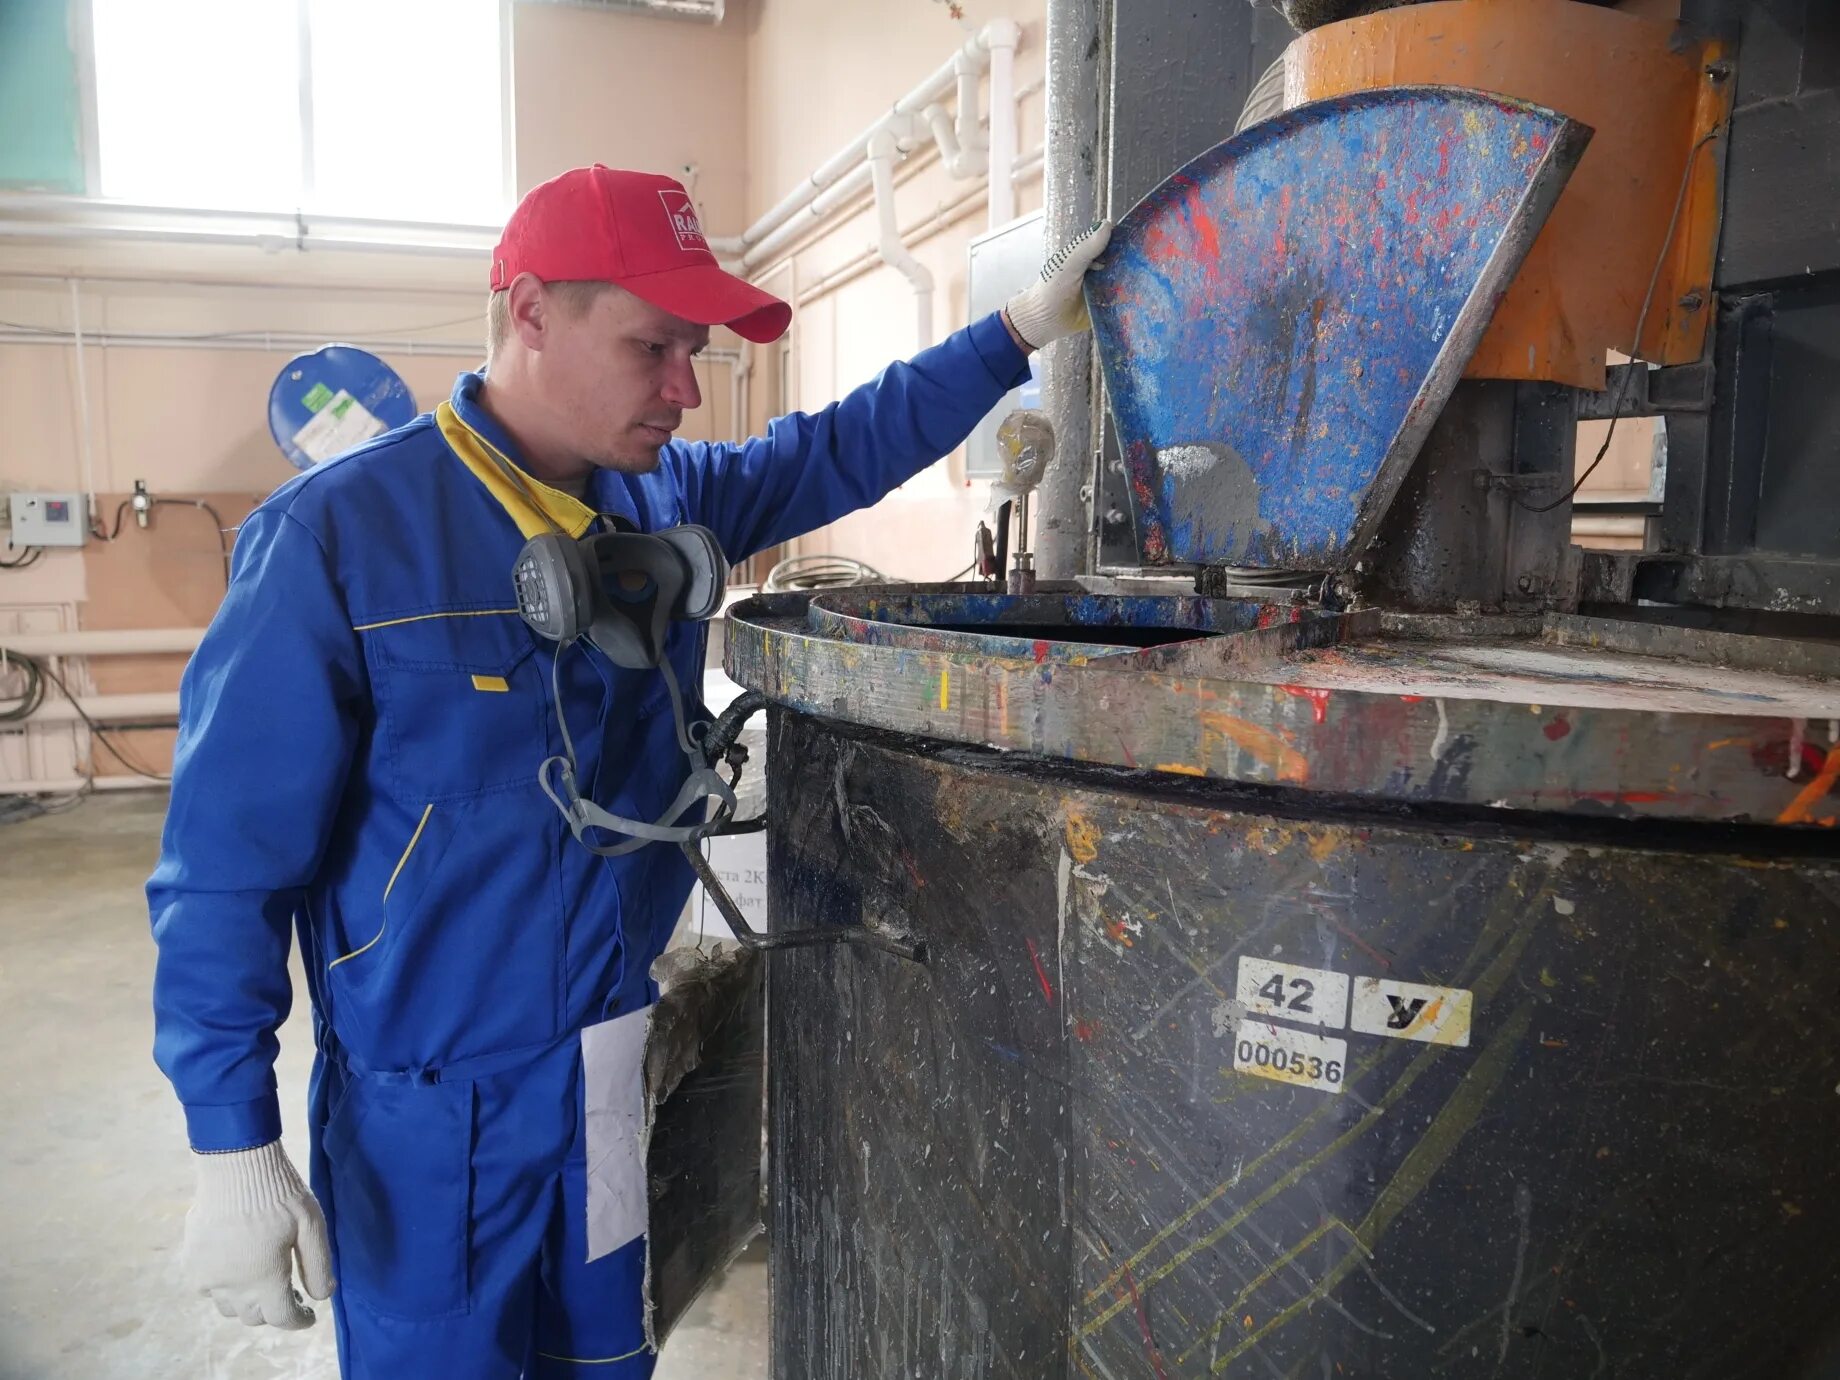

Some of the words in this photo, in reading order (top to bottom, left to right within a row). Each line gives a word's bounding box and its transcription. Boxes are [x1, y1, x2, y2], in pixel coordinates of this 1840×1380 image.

[715, 871, 740, 882] ста
[1258, 974, 1316, 1014] 42
[1237, 1039, 1342, 1083] 000536
